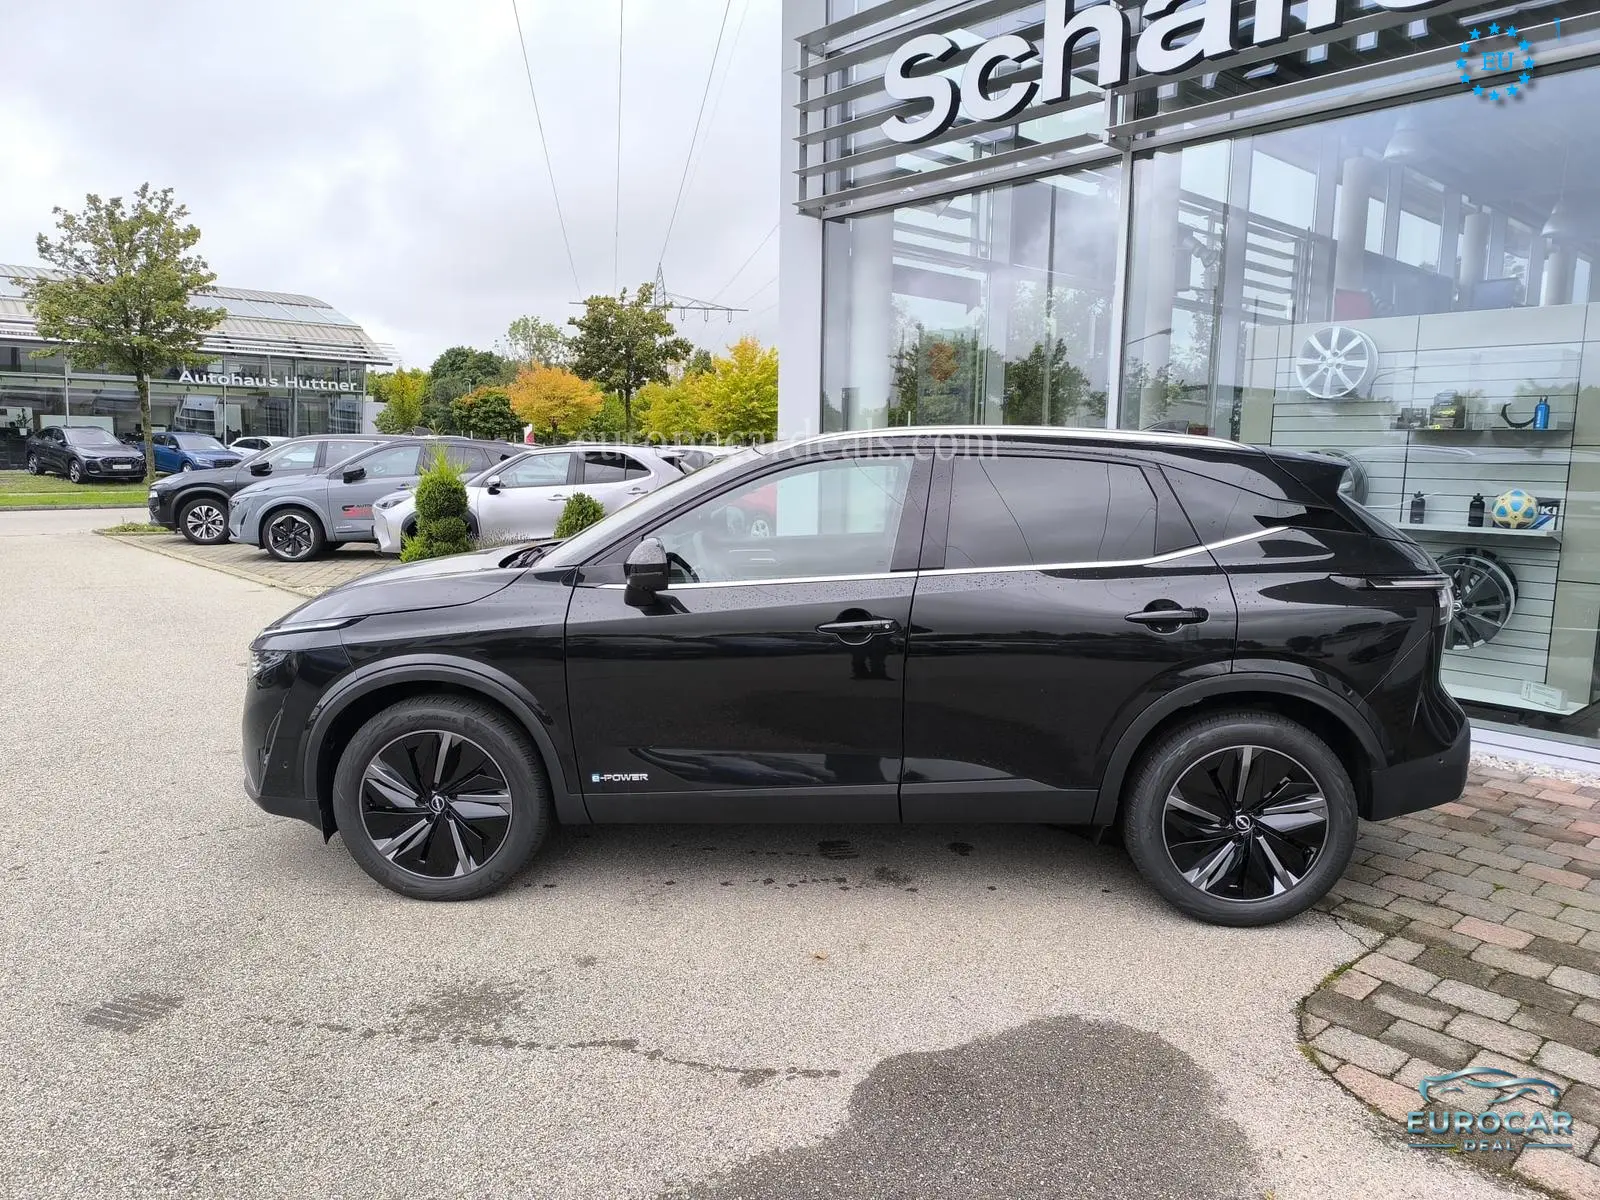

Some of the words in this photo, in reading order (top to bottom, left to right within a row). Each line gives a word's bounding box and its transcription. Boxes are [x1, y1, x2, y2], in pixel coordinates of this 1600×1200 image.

[878, 0, 1438, 144] Scha
[178, 370, 279, 388] Autohaus
[284, 375, 358, 392] Huttner
